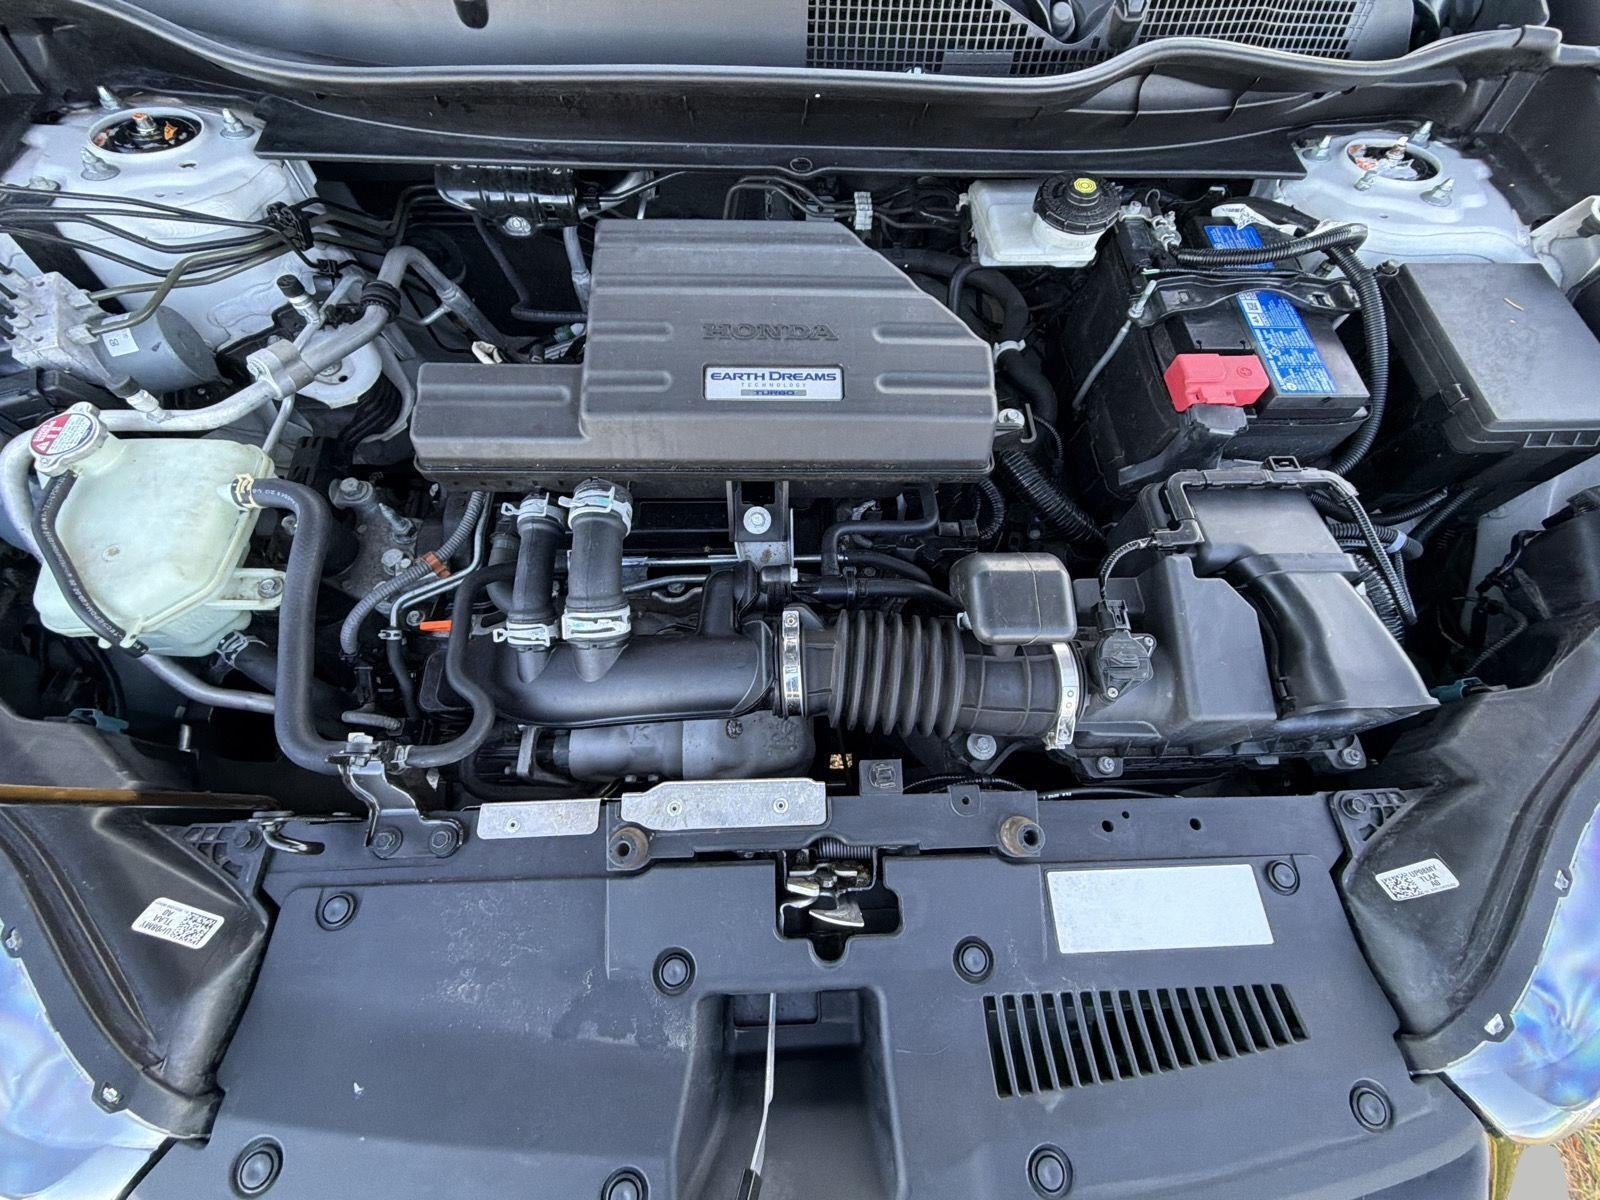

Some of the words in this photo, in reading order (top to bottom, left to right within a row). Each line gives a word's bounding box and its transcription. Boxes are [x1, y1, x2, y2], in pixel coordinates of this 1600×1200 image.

[702, 323, 839, 341] HONDA
[710, 371, 766, 382] EARTH
[769, 371, 837, 382] DREAMS
[753, 389, 796, 397] TURBO
